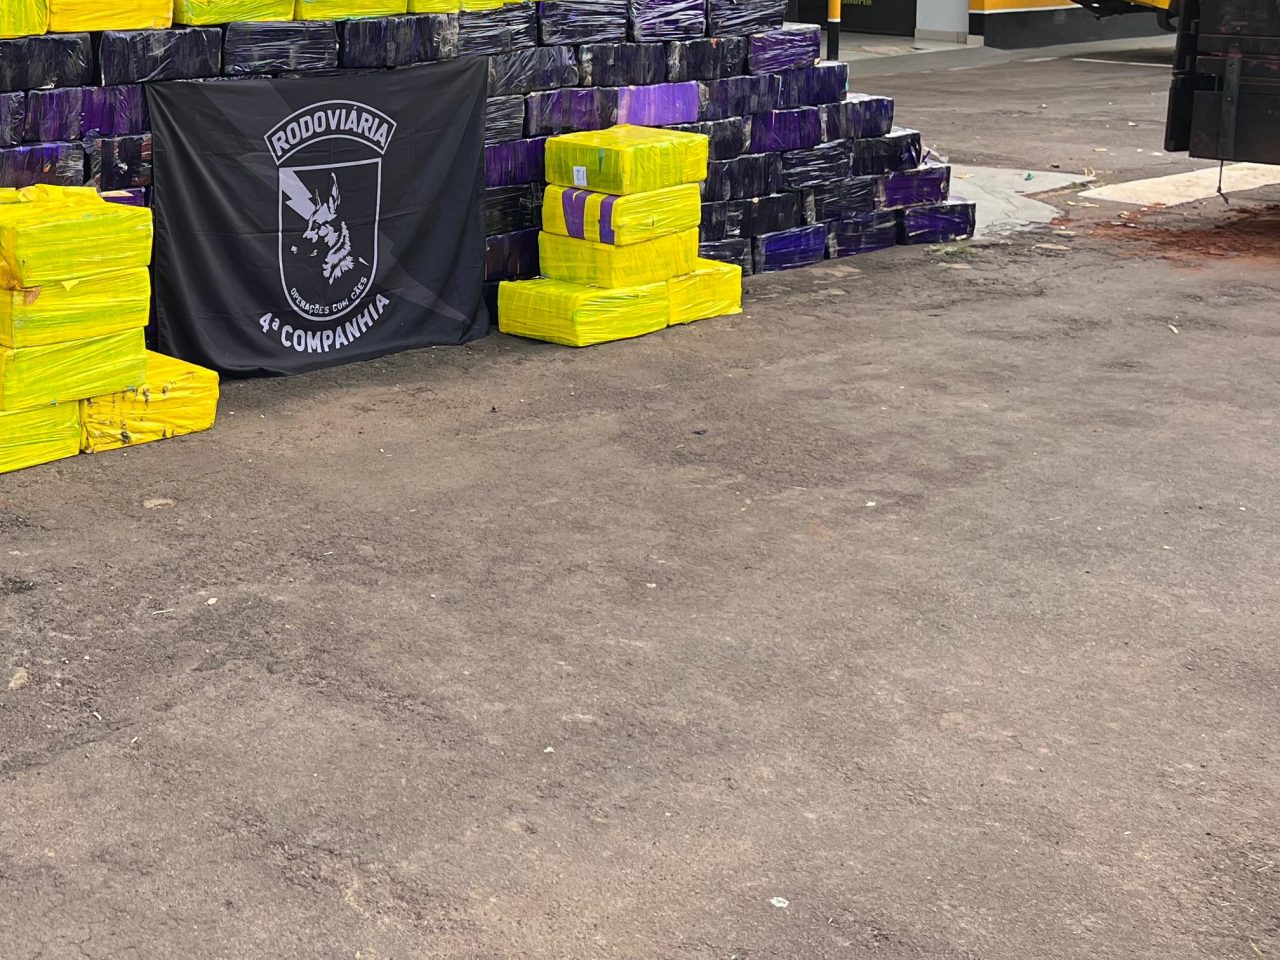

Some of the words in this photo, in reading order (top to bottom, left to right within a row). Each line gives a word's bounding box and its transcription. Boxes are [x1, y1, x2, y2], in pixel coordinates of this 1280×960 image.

[271, 106, 389, 156] RODOVIÁRIA
[290, 287, 330, 314] OPERAÇÕES
[350, 276, 368, 300] CÃES
[281, 293, 390, 353] COMPANHIA
